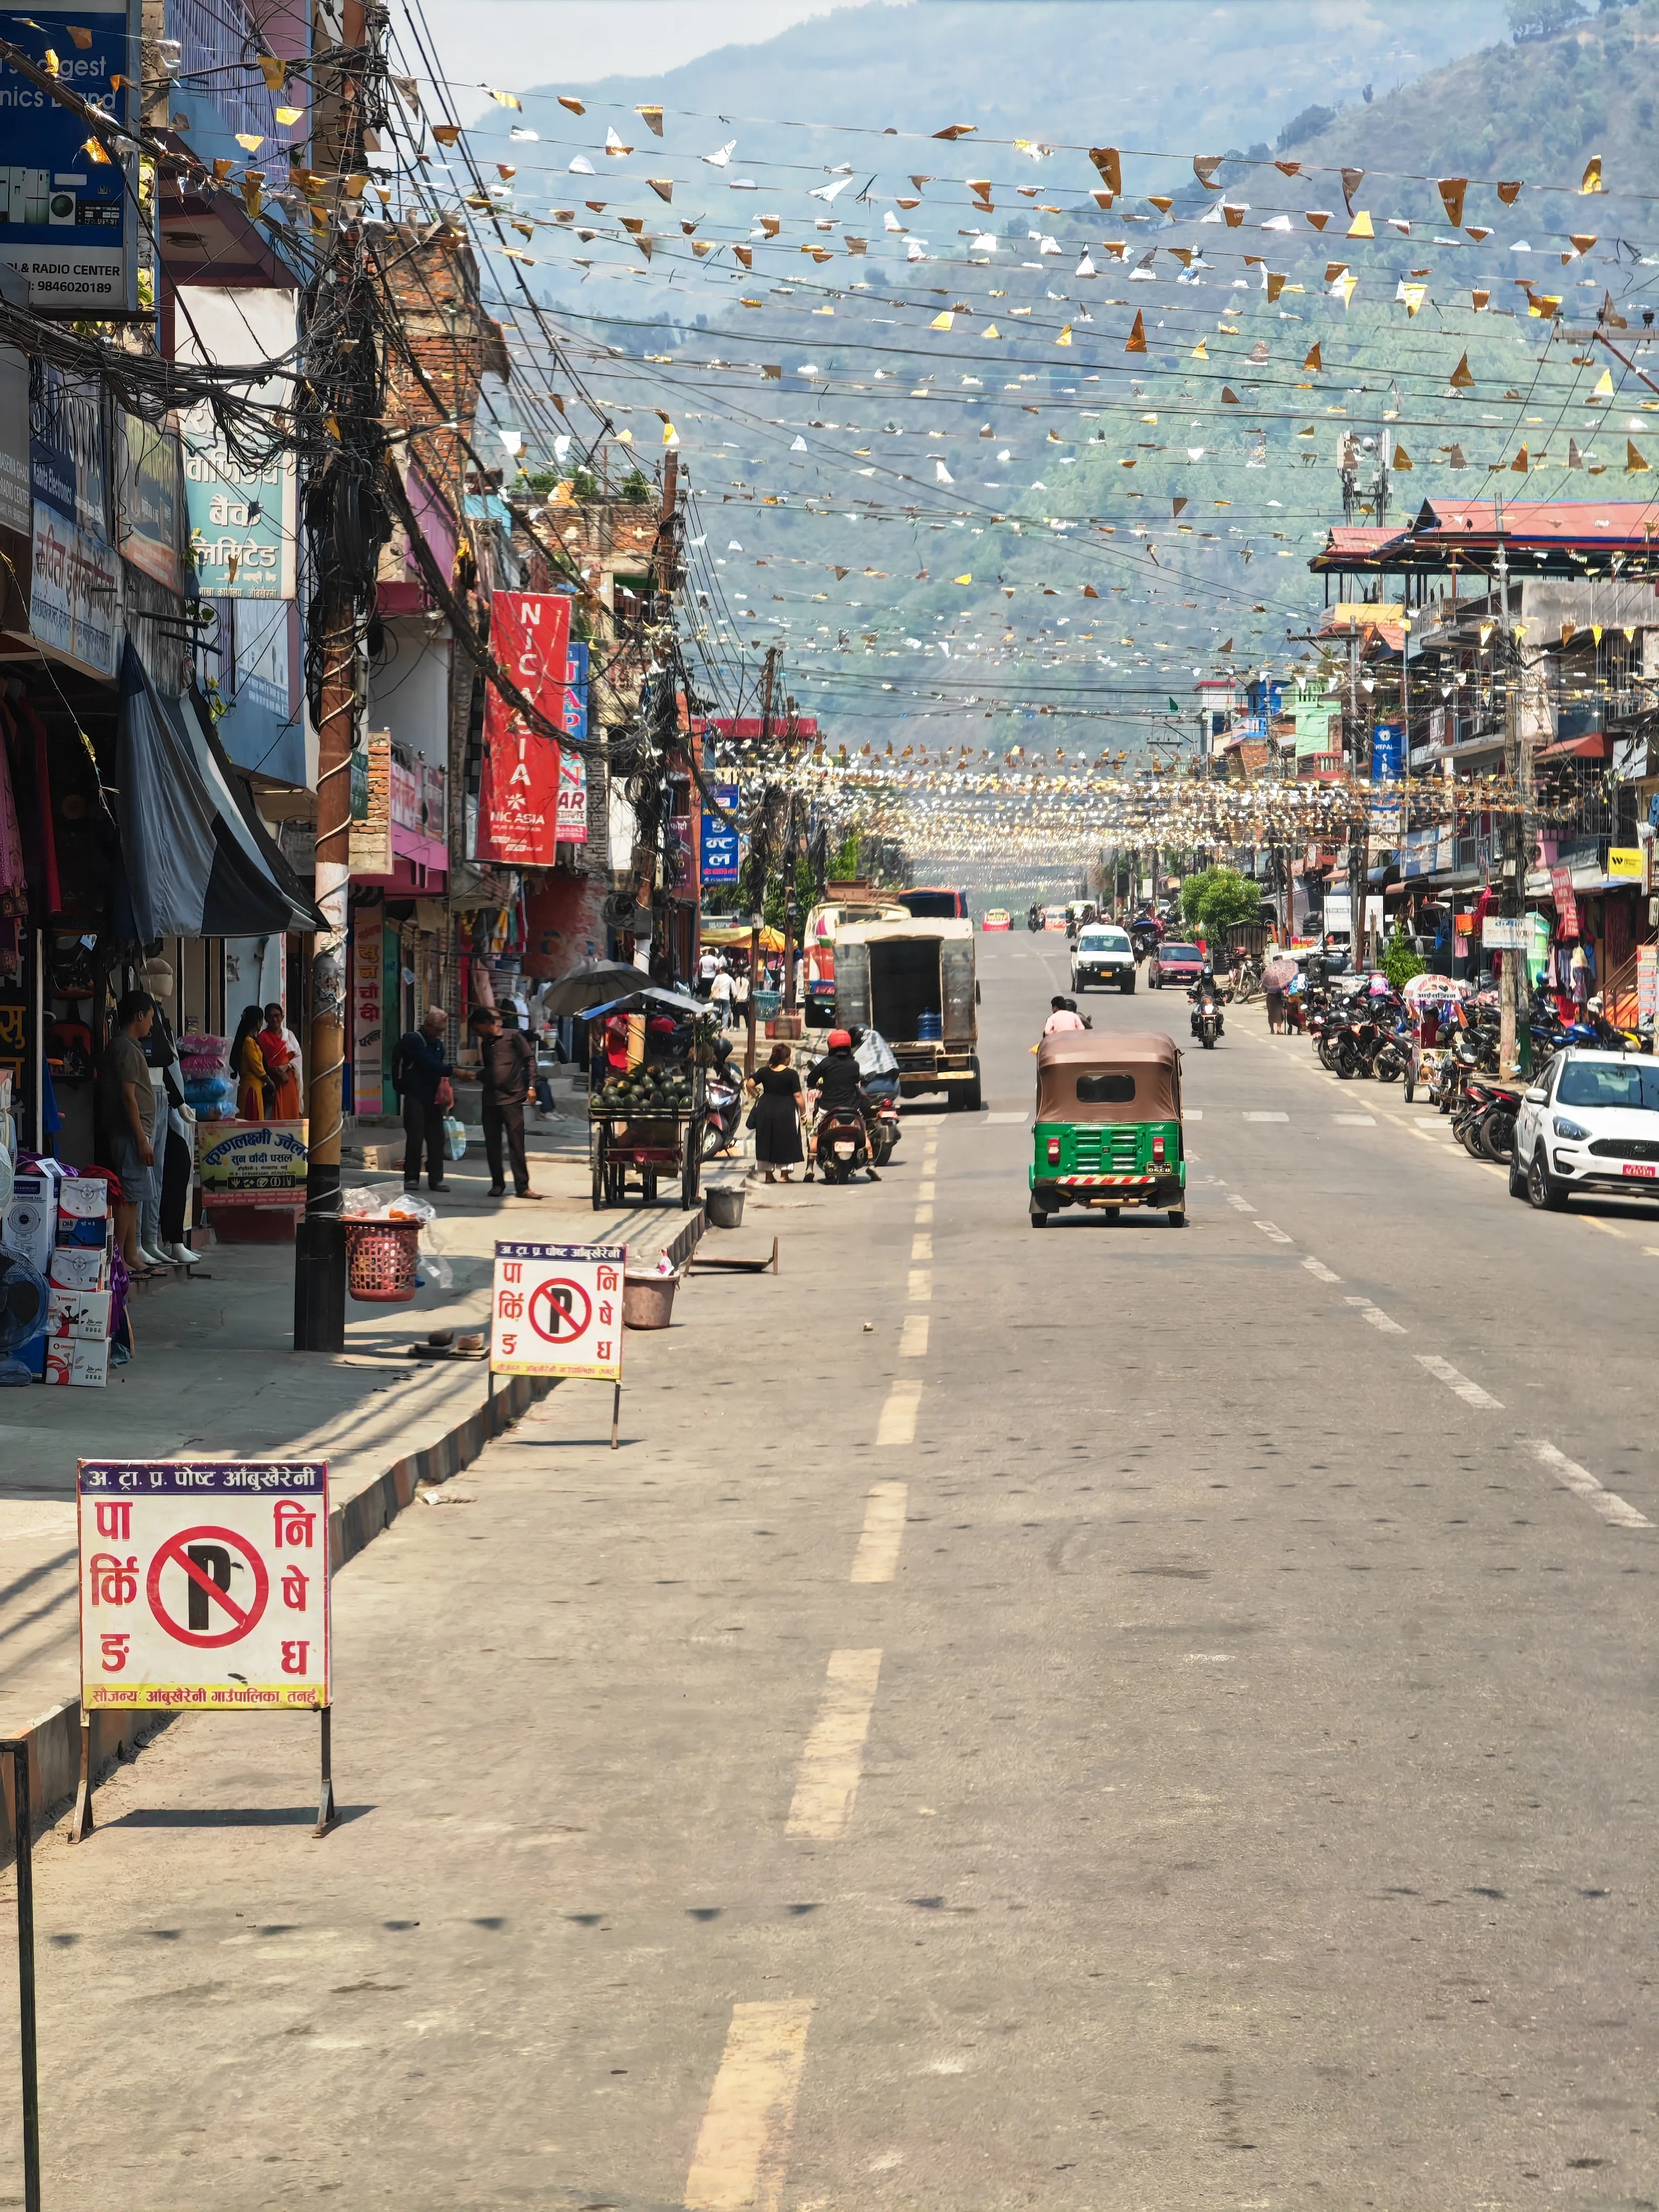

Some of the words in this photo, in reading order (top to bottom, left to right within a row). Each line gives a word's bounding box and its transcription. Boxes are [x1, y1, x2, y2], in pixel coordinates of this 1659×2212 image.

[32, 264, 70, 274] RADIO
[73, 265, 120, 276] CENTER
[38, 281, 112, 293] 9846020189
[490, 811, 512, 822] NIC
